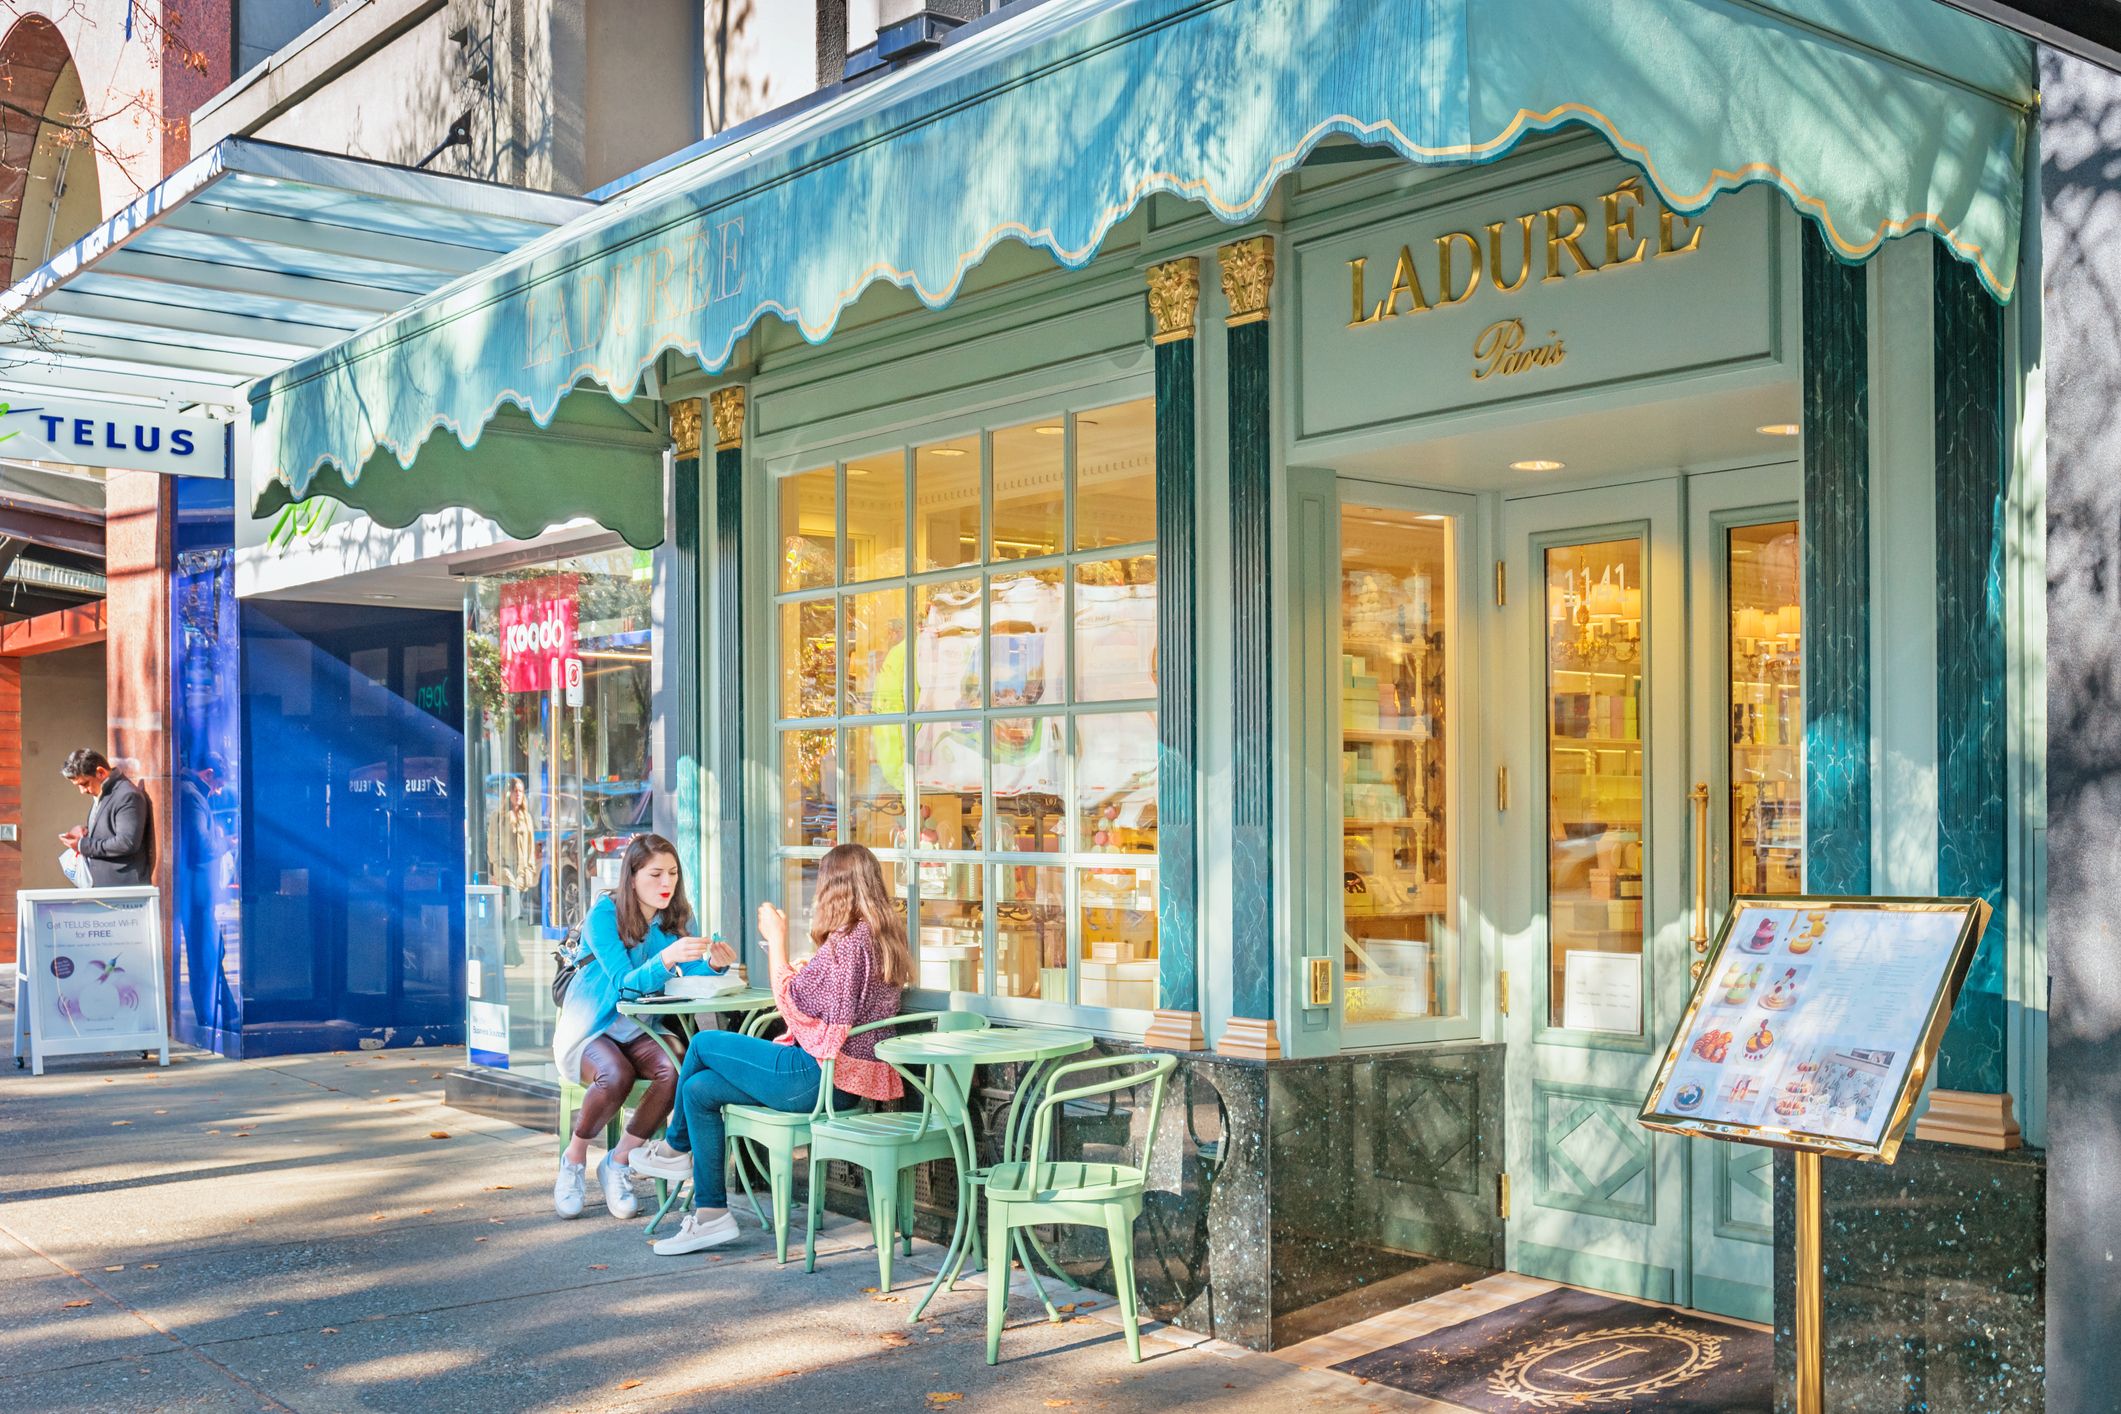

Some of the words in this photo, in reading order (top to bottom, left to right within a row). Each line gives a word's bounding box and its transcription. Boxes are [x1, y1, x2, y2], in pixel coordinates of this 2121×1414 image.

[1345, 175, 1704, 329] LADURÉE
[523, 216, 745, 369] LADURÉE
[1471, 318, 1568, 381] Paris
[39, 415, 195, 455] TELUS
[1564, 562, 1627, 607] 1141
[64, 920, 90, 929] TELUS
[93, 919, 115, 928] Boost
[88, 930, 112, 938] FREE
